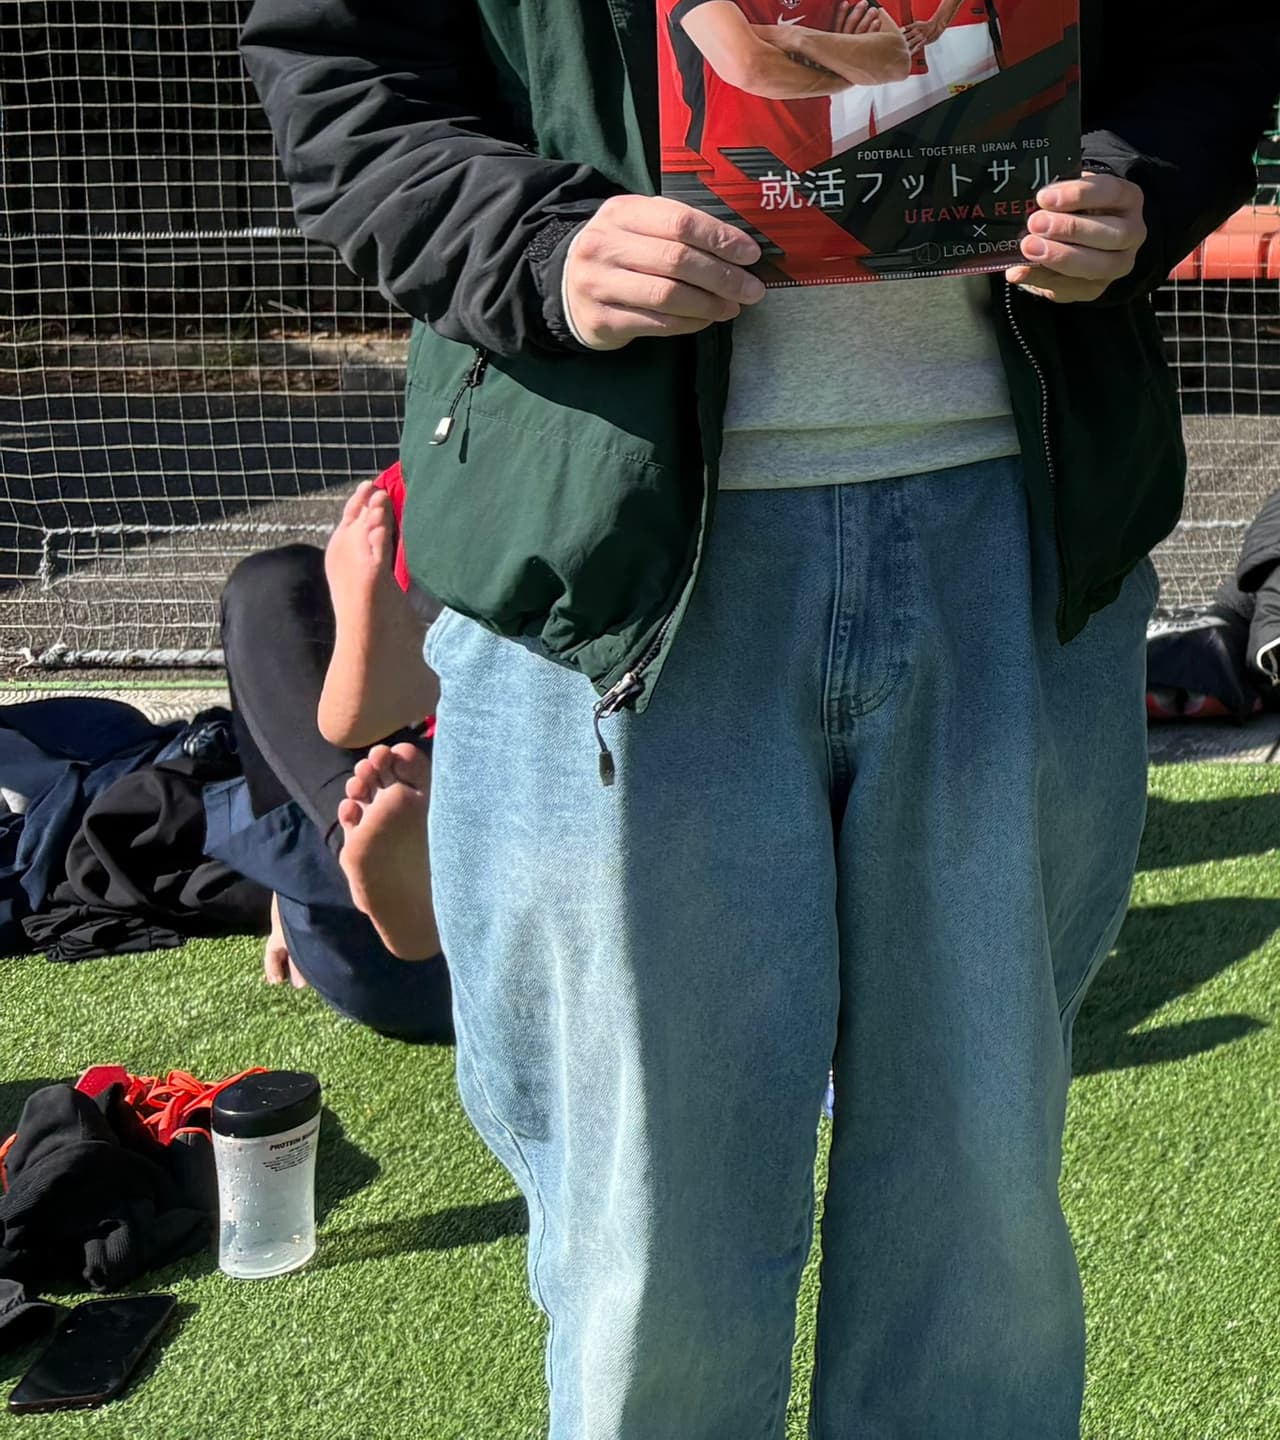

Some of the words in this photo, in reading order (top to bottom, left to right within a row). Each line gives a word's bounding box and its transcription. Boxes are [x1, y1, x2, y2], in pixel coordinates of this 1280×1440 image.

[857, 148, 913, 160] FOOTBALL
[920, 144, 976, 157] TOGETHER
[982, 142, 1017, 153] URAWA
[1022, 138, 1050, 149] REDS
[758, 155, 1060, 210] 就活フットサル
[904, 205, 985, 224] URAWA
[994, 200, 1040, 216] RED
